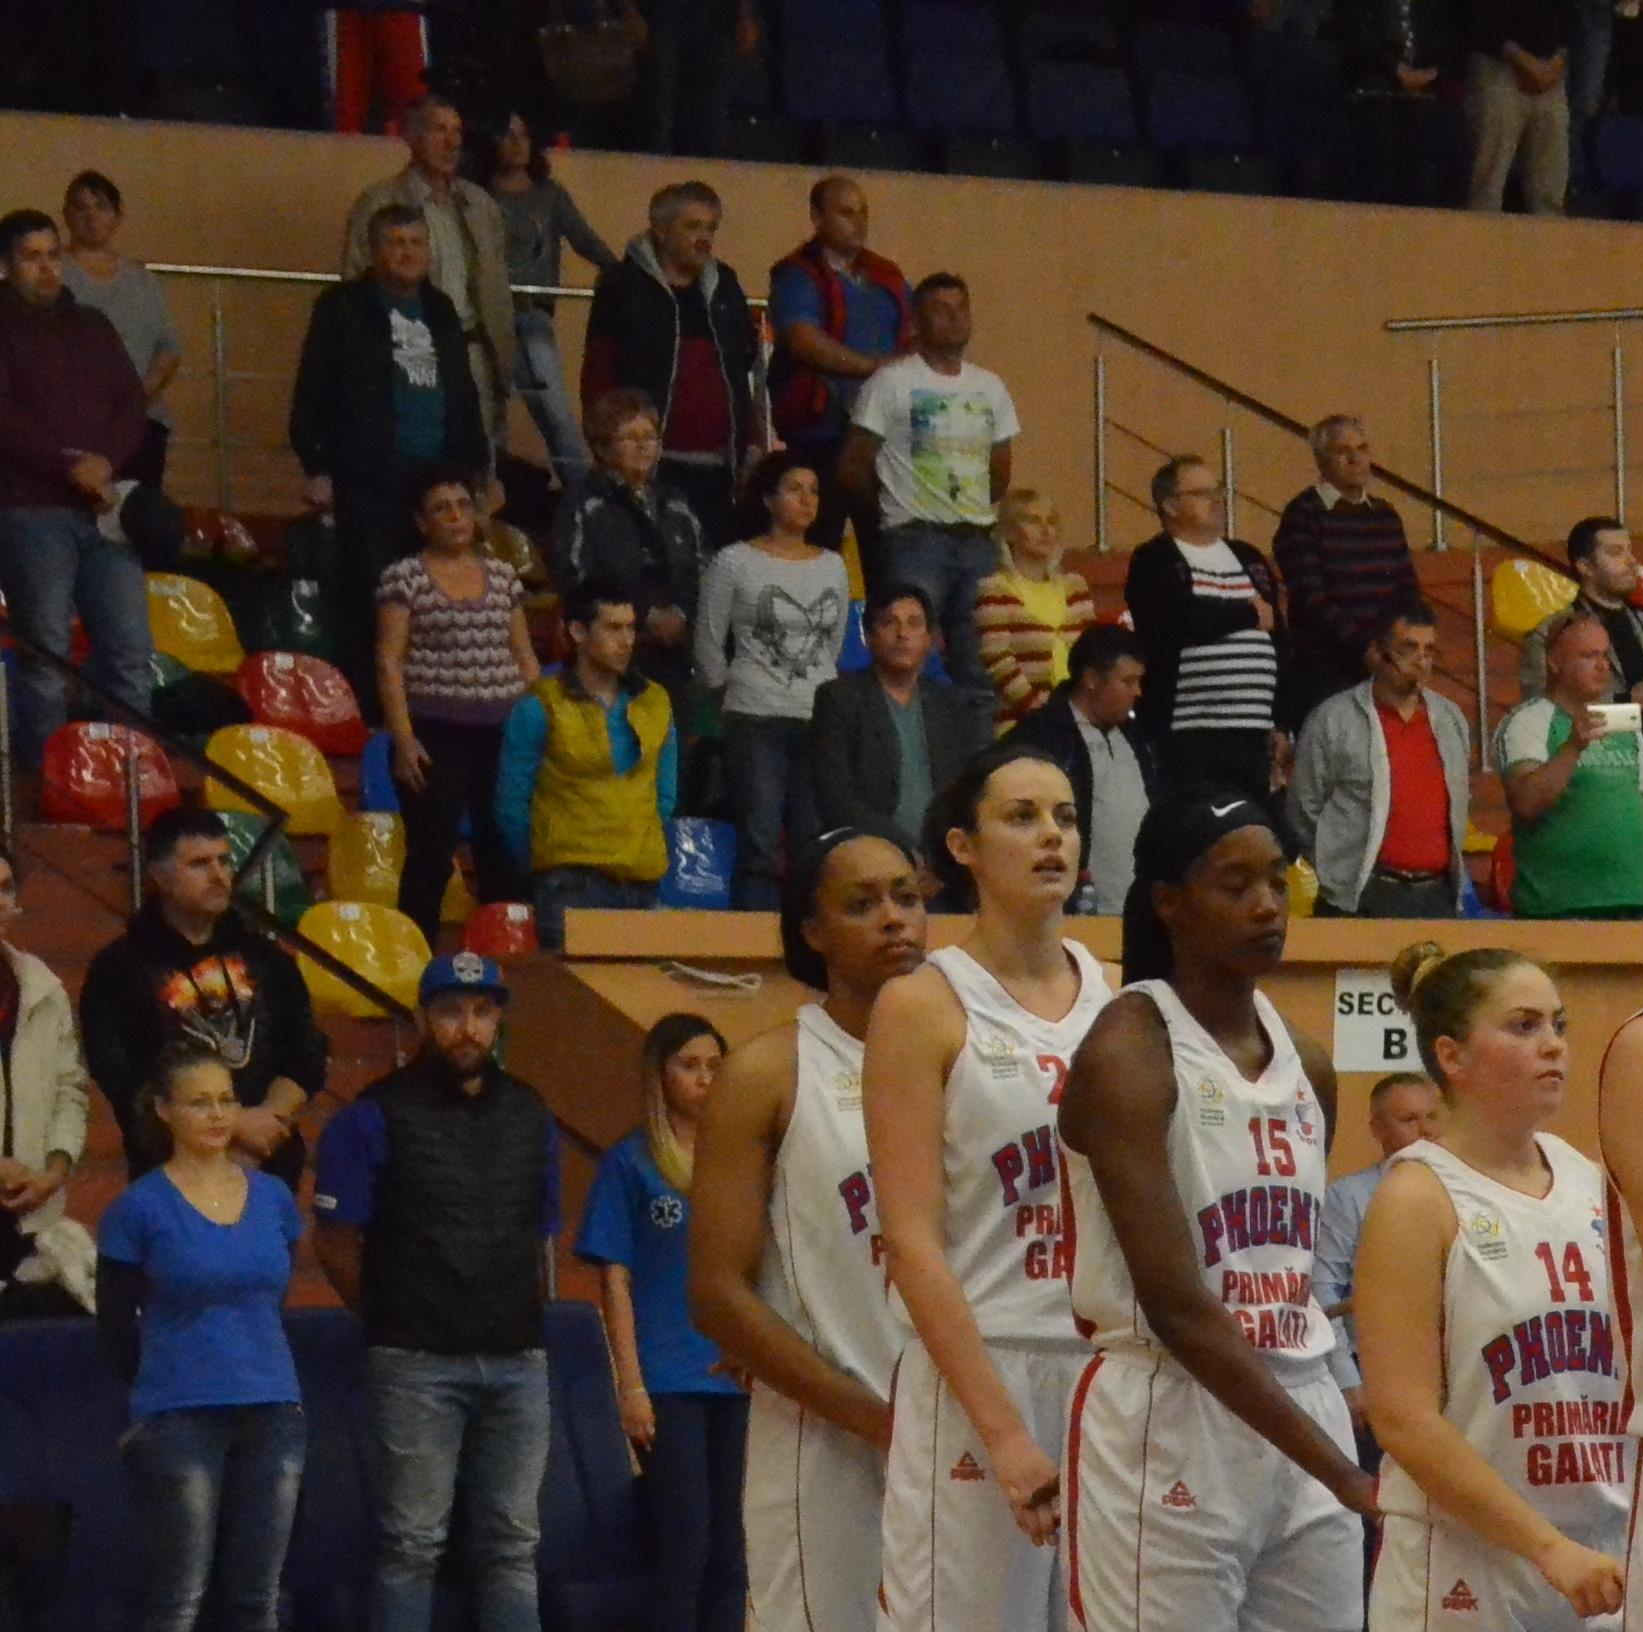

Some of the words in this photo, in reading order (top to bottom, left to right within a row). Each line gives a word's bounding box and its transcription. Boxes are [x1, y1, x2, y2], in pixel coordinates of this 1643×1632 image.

[1337, 991, 1407, 1017] SEC
[1383, 1028, 1408, 1060] B
[1249, 1117, 1297, 1177] 15
[1535, 1241, 1595, 1303] 14
[1481, 1309, 1619, 1405] PHOEN
